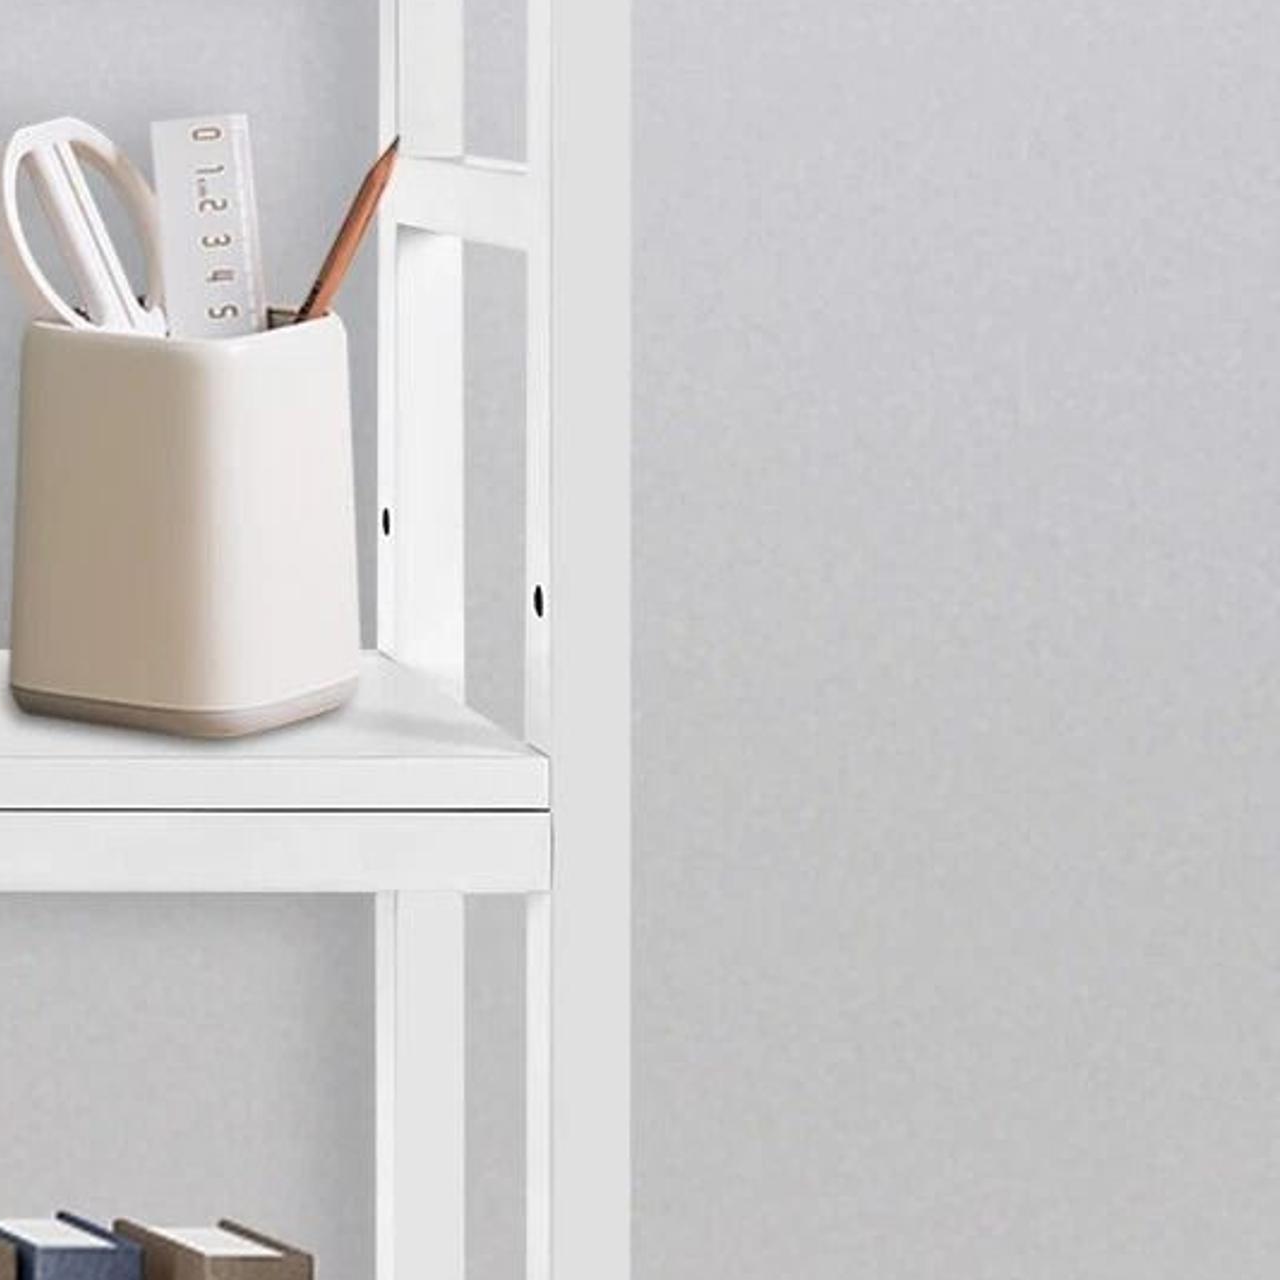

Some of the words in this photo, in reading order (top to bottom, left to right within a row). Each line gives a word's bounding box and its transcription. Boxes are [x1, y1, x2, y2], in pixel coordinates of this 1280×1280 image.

[192, 127, 222, 141] 0
[195, 164, 225, 175] 1
[199, 198, 228, 213] 2
[201, 233, 232, 248] 3
[205, 268, 235, 282] 4
[208, 304, 239, 319] 5
